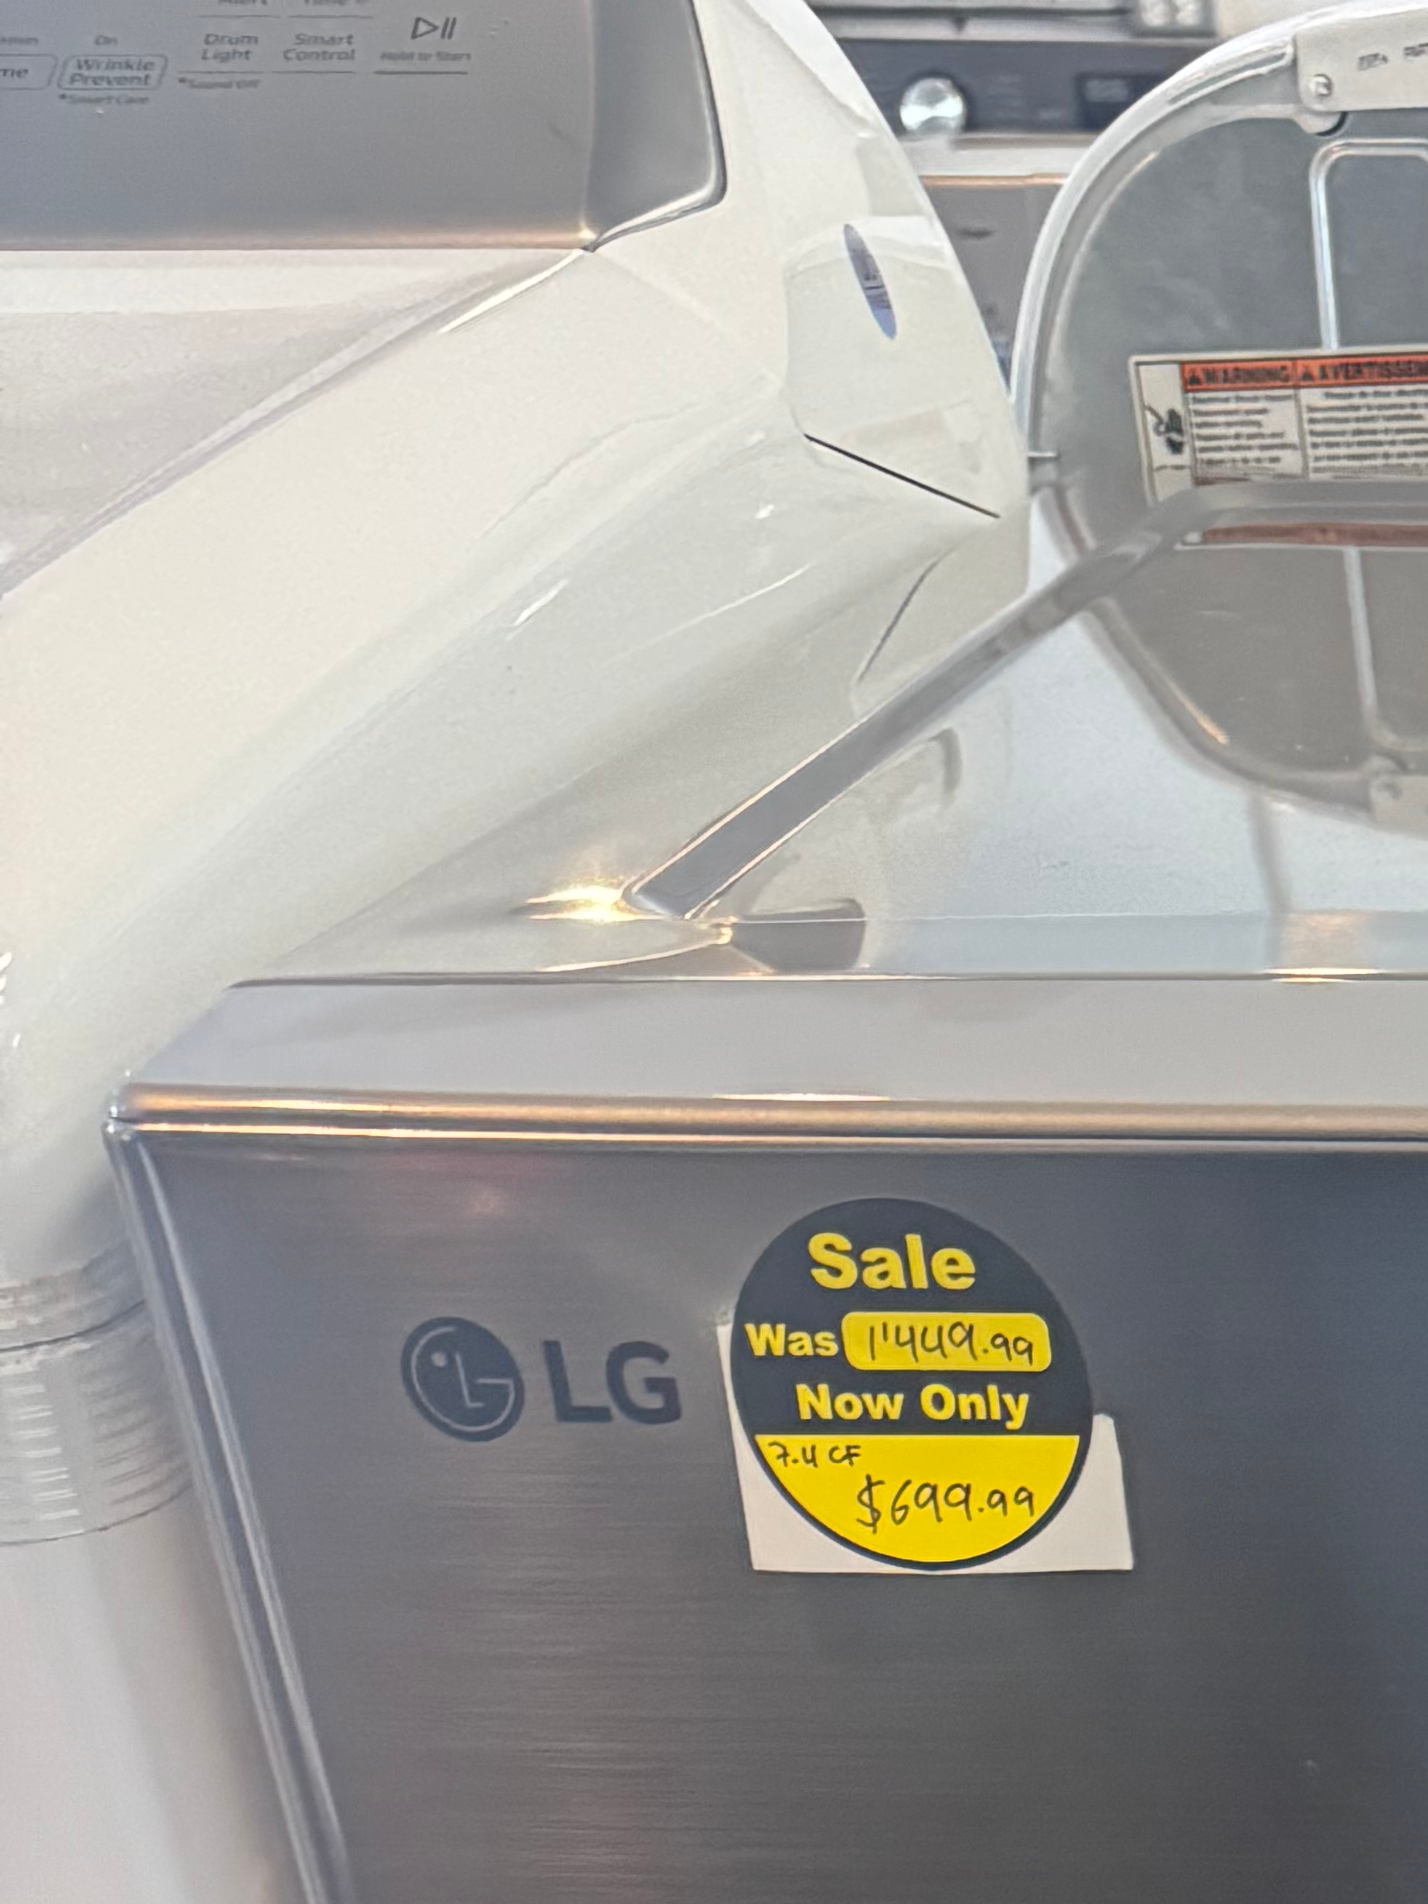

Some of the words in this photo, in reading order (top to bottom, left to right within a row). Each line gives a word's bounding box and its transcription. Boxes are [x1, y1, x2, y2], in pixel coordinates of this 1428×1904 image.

[204, 33, 258, 45] Drum
[294, 32, 353, 45] Smart
[76, 58, 156, 71] Wrinkle
[201, 49, 252, 63] Light
[283, 48, 355, 61] Control
[68, 73, 152, 86] Prevent
[1203, 364, 1291, 385] WARNING
[807, 1232, 976, 1291] Sale
[745, 1323, 838, 1357] Was
[542, 1339, 682, 1425] LG
[796, 1383, 904, 1421] Now
[920, 1383, 1030, 1430] Only
[768, 1441, 817, 1467] 7.4
[828, 1444, 861, 1466] CF
[856, 1474, 1035, 1534] $699.99
